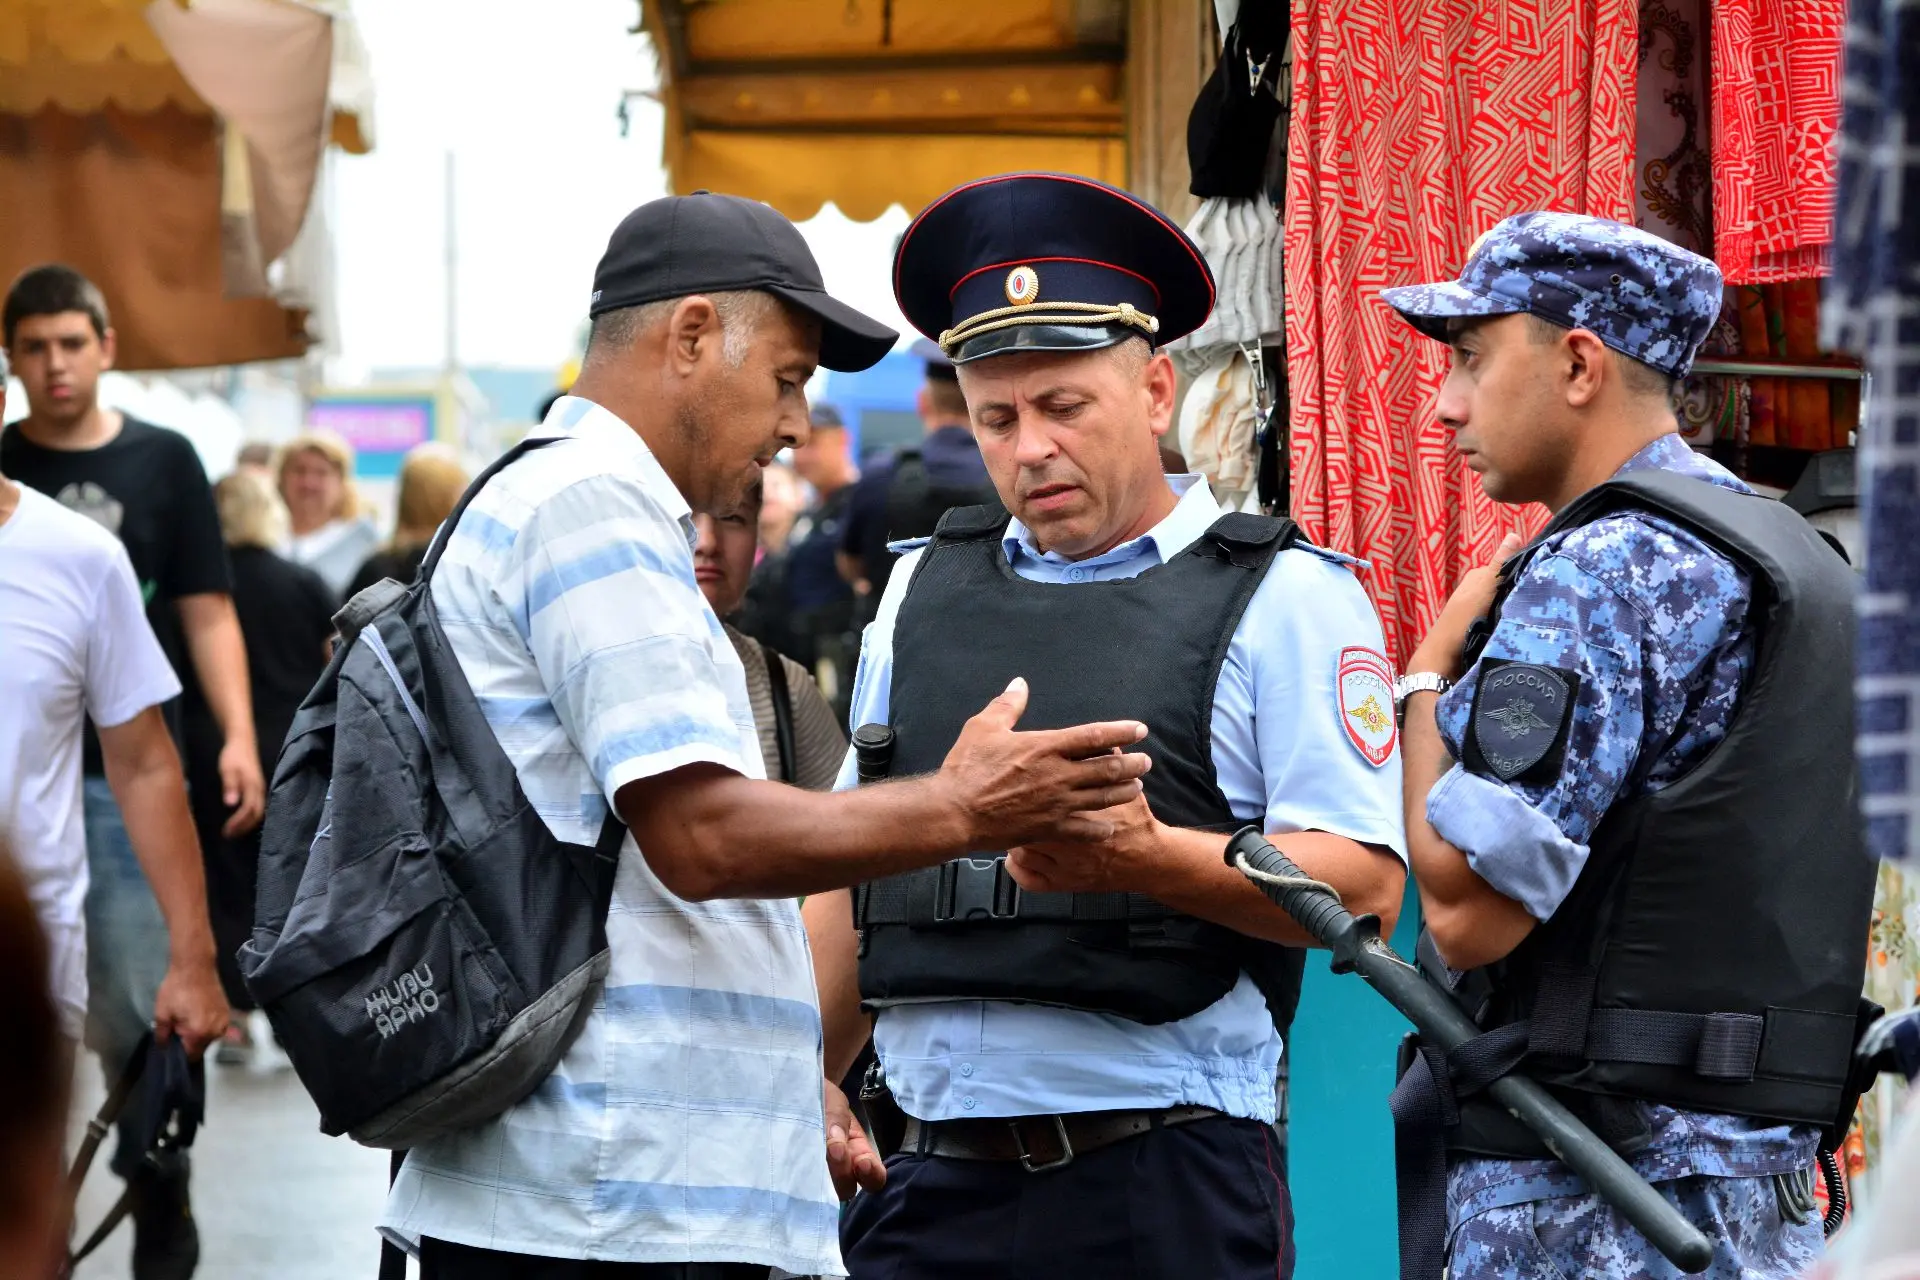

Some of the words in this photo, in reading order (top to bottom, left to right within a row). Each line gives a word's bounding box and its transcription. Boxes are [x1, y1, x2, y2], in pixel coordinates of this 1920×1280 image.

[1348, 674, 1390, 699] РОССИЯ
[1492, 673, 1556, 704] РОССИЯ
[1365, 742, 1385, 761] МВД
[1491, 752, 1523, 772] МВД
